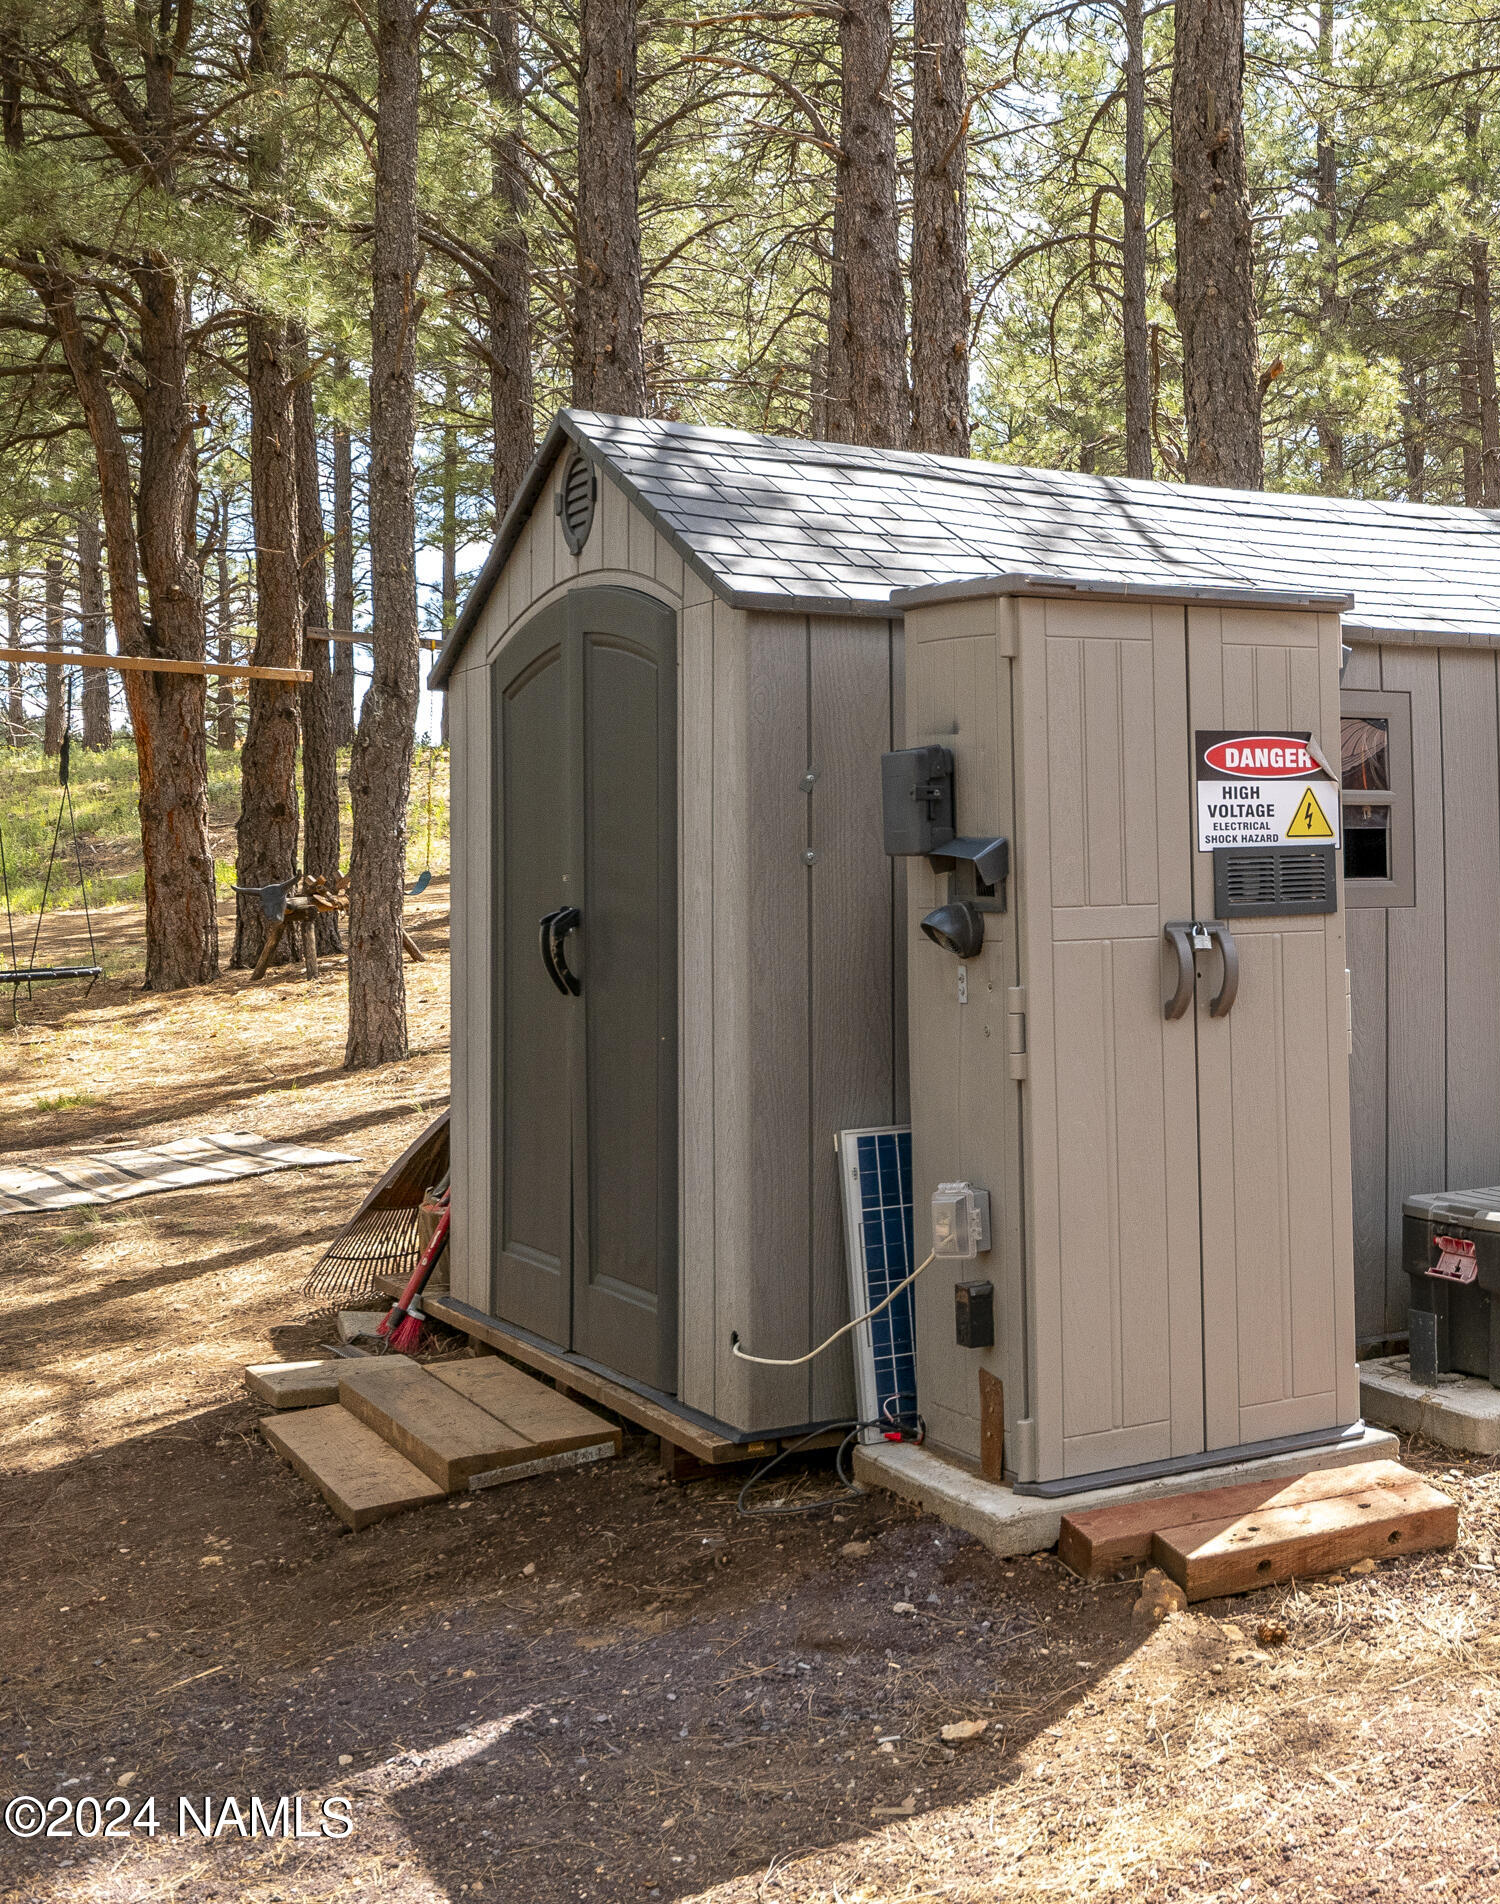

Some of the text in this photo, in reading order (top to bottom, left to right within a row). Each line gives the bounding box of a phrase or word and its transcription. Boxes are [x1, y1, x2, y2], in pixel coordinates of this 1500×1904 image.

[1225, 747, 1312, 768] DANGER
[1222, 785, 1260, 800] HIGH
[1207, 803, 1275, 818] VOLTAGE
[1213, 821, 1271, 831] ELECTRICAL
[1205, 833, 1279, 844] SHOCK HAZARD
